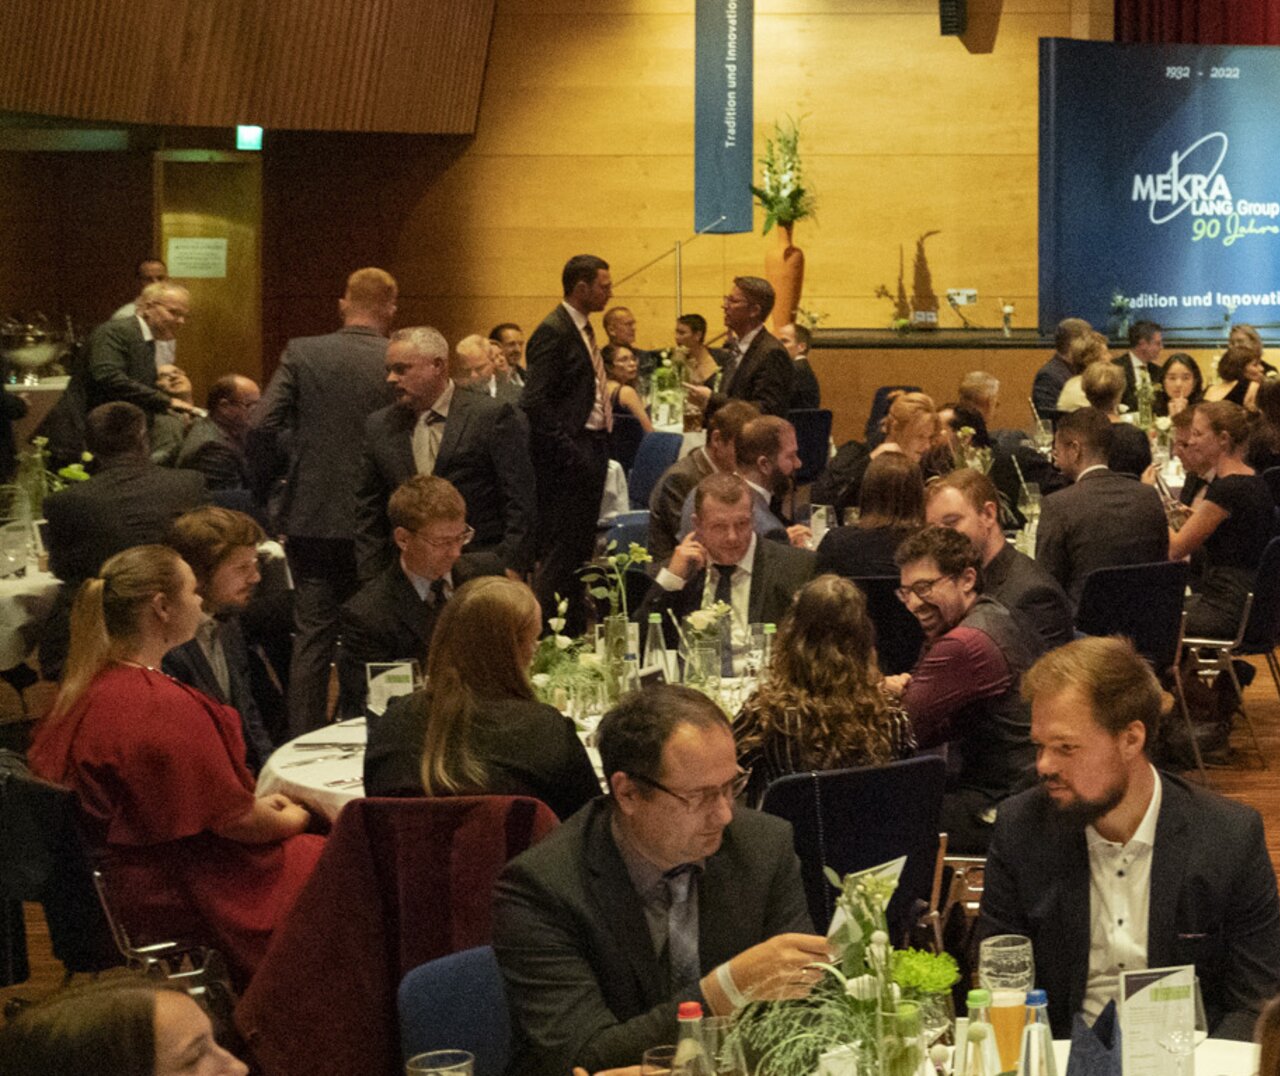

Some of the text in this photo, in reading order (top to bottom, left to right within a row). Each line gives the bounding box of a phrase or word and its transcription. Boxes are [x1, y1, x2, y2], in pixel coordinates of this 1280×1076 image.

[725, 0, 737, 148] Tradition und Innovatio
[1166, 66, 1190, 80] 1932
[1209, 66, 1240, 79] 2022
[1132, 151, 1233, 205] MEKRA
[1191, 199, 1280, 219] LANG Group
[1191, 211, 1280, 247] 90 Jahre
[1182, 291, 1213, 307] und
